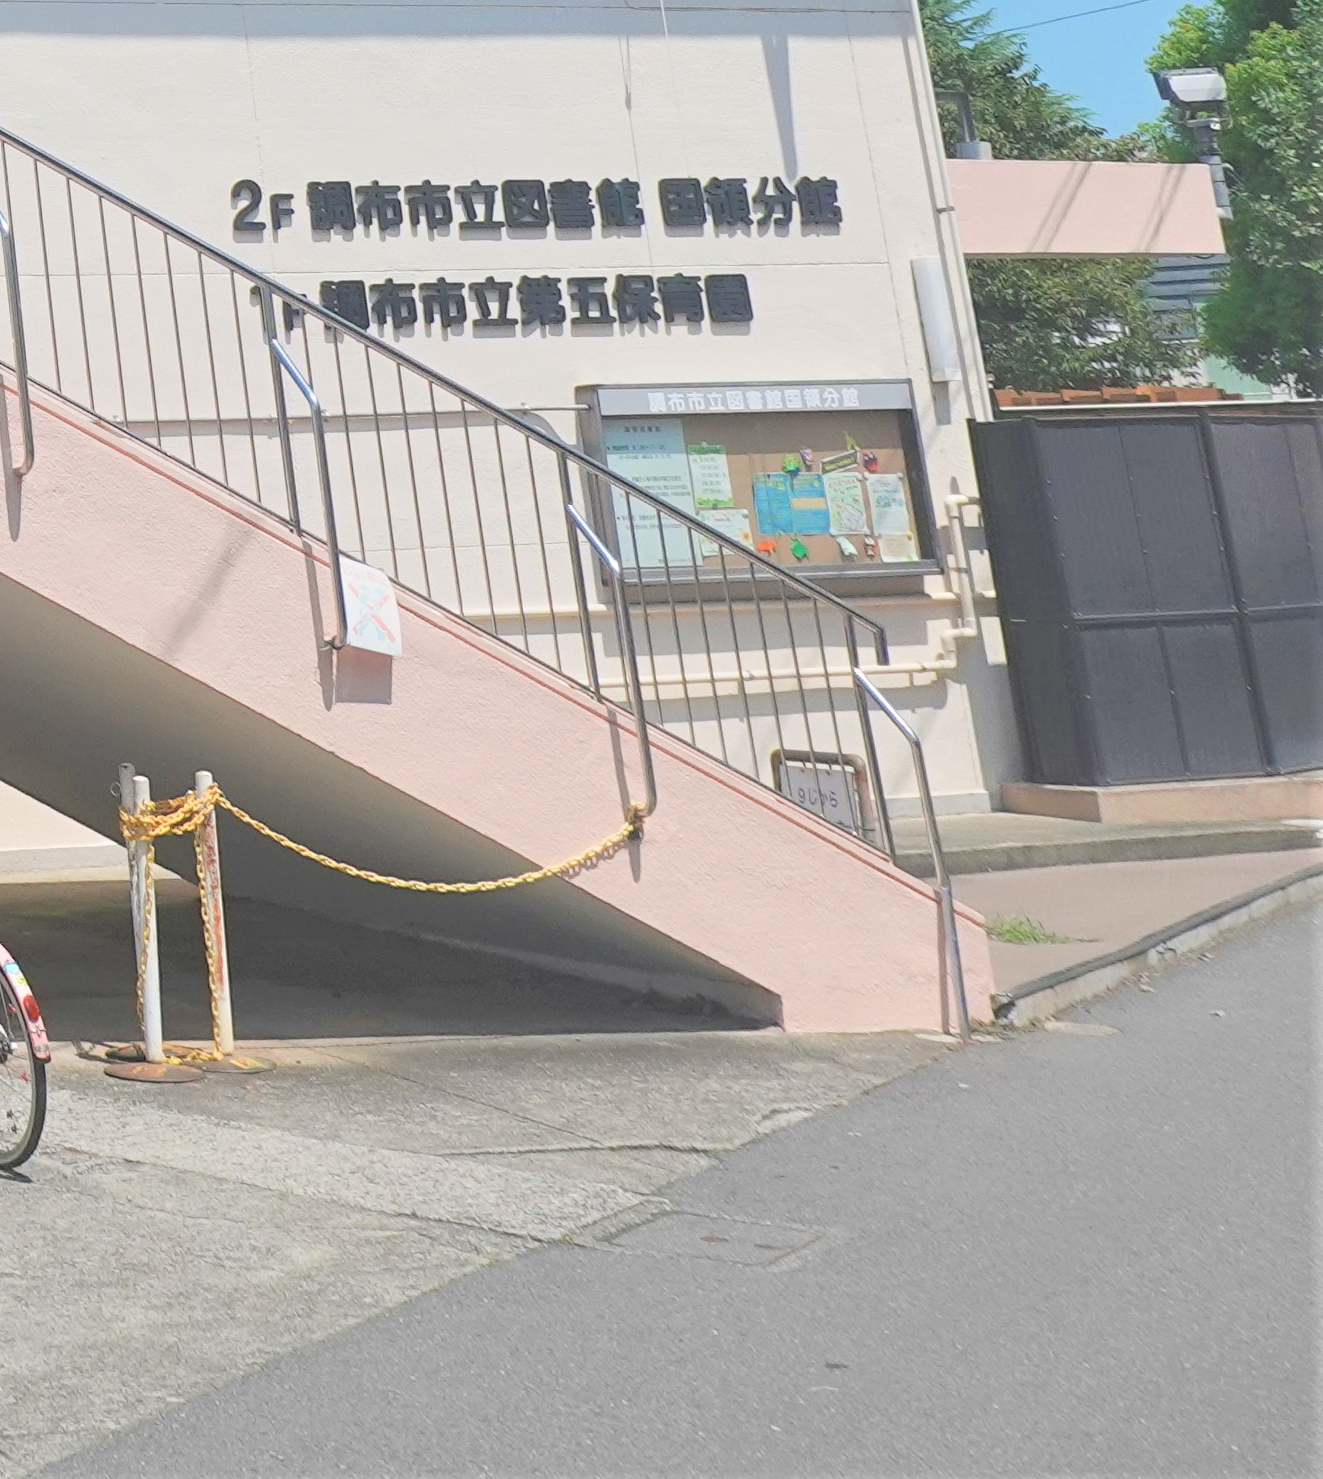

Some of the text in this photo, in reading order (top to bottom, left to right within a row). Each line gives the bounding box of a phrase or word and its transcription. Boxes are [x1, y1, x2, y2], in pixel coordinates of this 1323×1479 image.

[230, 175, 844, 231] 2F 調布市立図書館 国領分館
[320, 272, 754, 332] 調布市立第五保育園
[648, 387, 860, 414] 調布市立図書館国領分館
